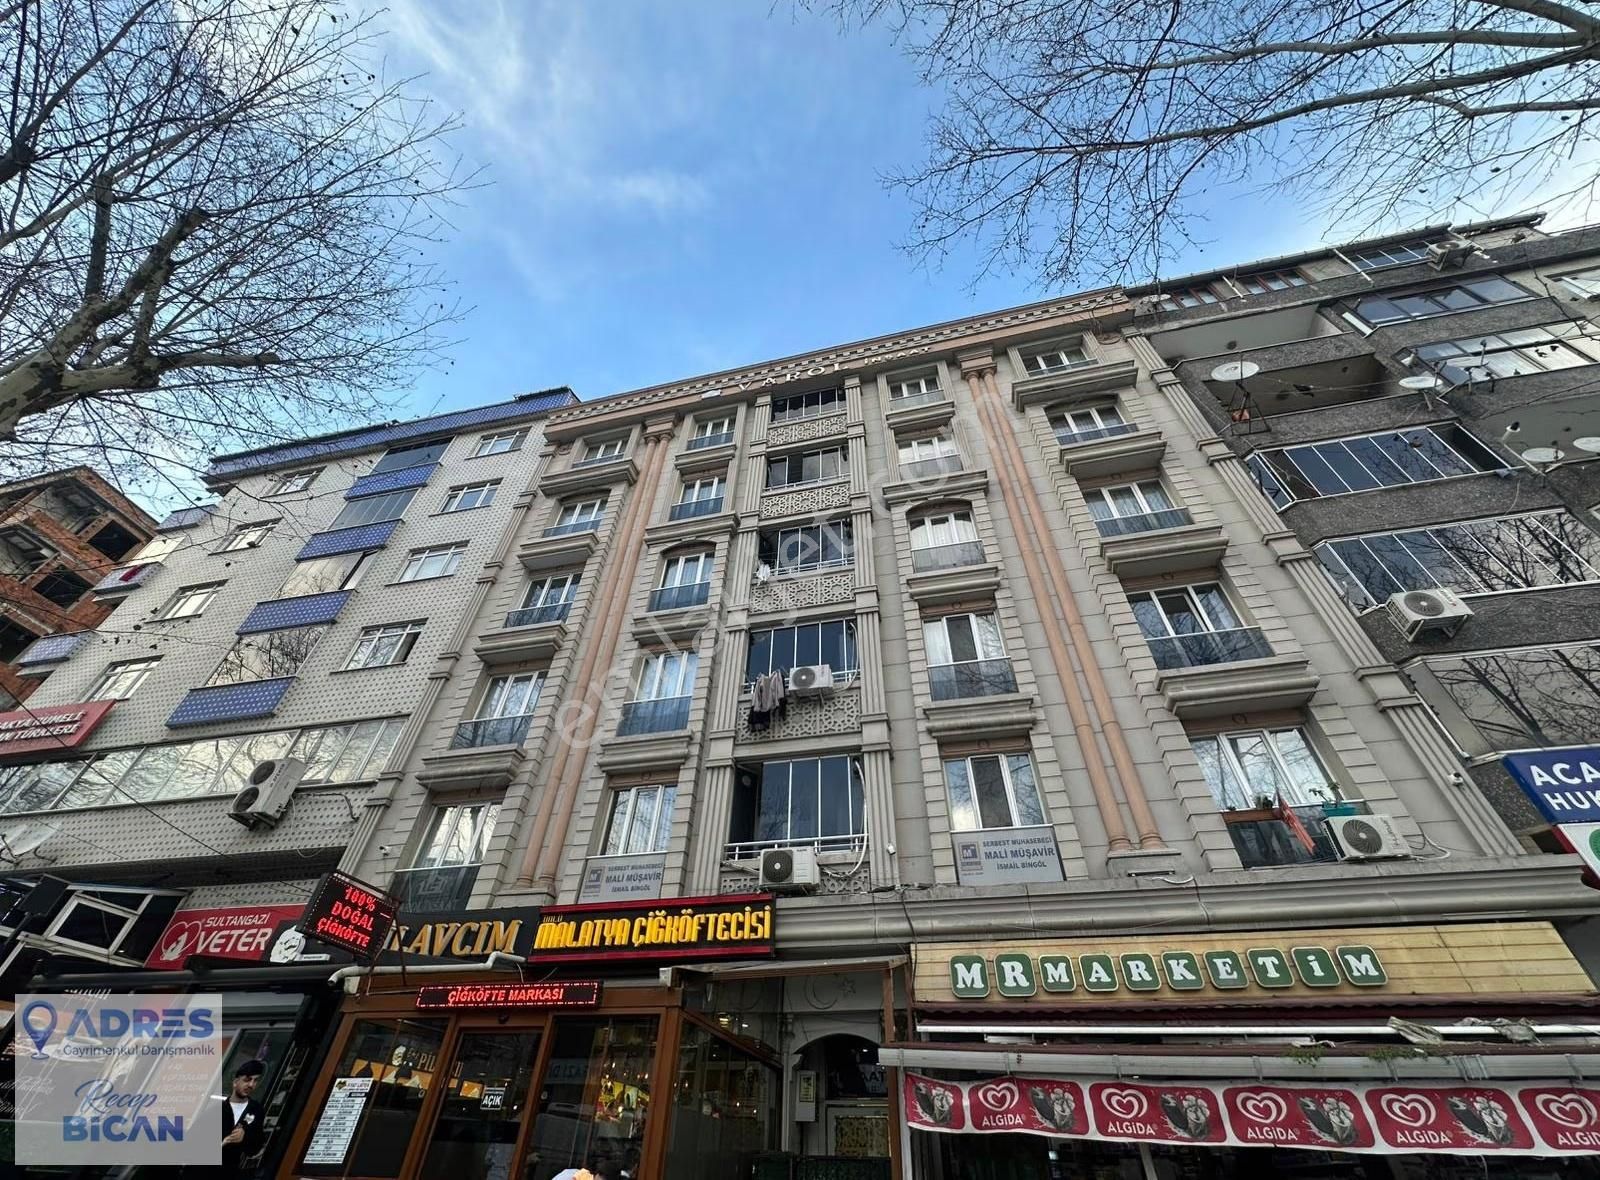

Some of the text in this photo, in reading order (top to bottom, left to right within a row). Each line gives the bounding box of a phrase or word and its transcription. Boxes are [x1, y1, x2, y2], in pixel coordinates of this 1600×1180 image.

[738, 363, 848, 392] VAROL
[984, 847, 1055, 860] MALİ MÜŞAVİR
[345, 886, 376, 911] 100%
[204, 912, 271, 928] SULTANGAZİ
[331, 901, 374, 931] DOĞAL
[533, 905, 772, 949] MALATYA ÇİĞKÖFTECİSİ
[316, 916, 371, 948] ÇİĞKÖFTE
[448, 986, 564, 1006] ÇİĞKÖFTE MARKASI
[482, 1095, 502, 1108] AÇIK
